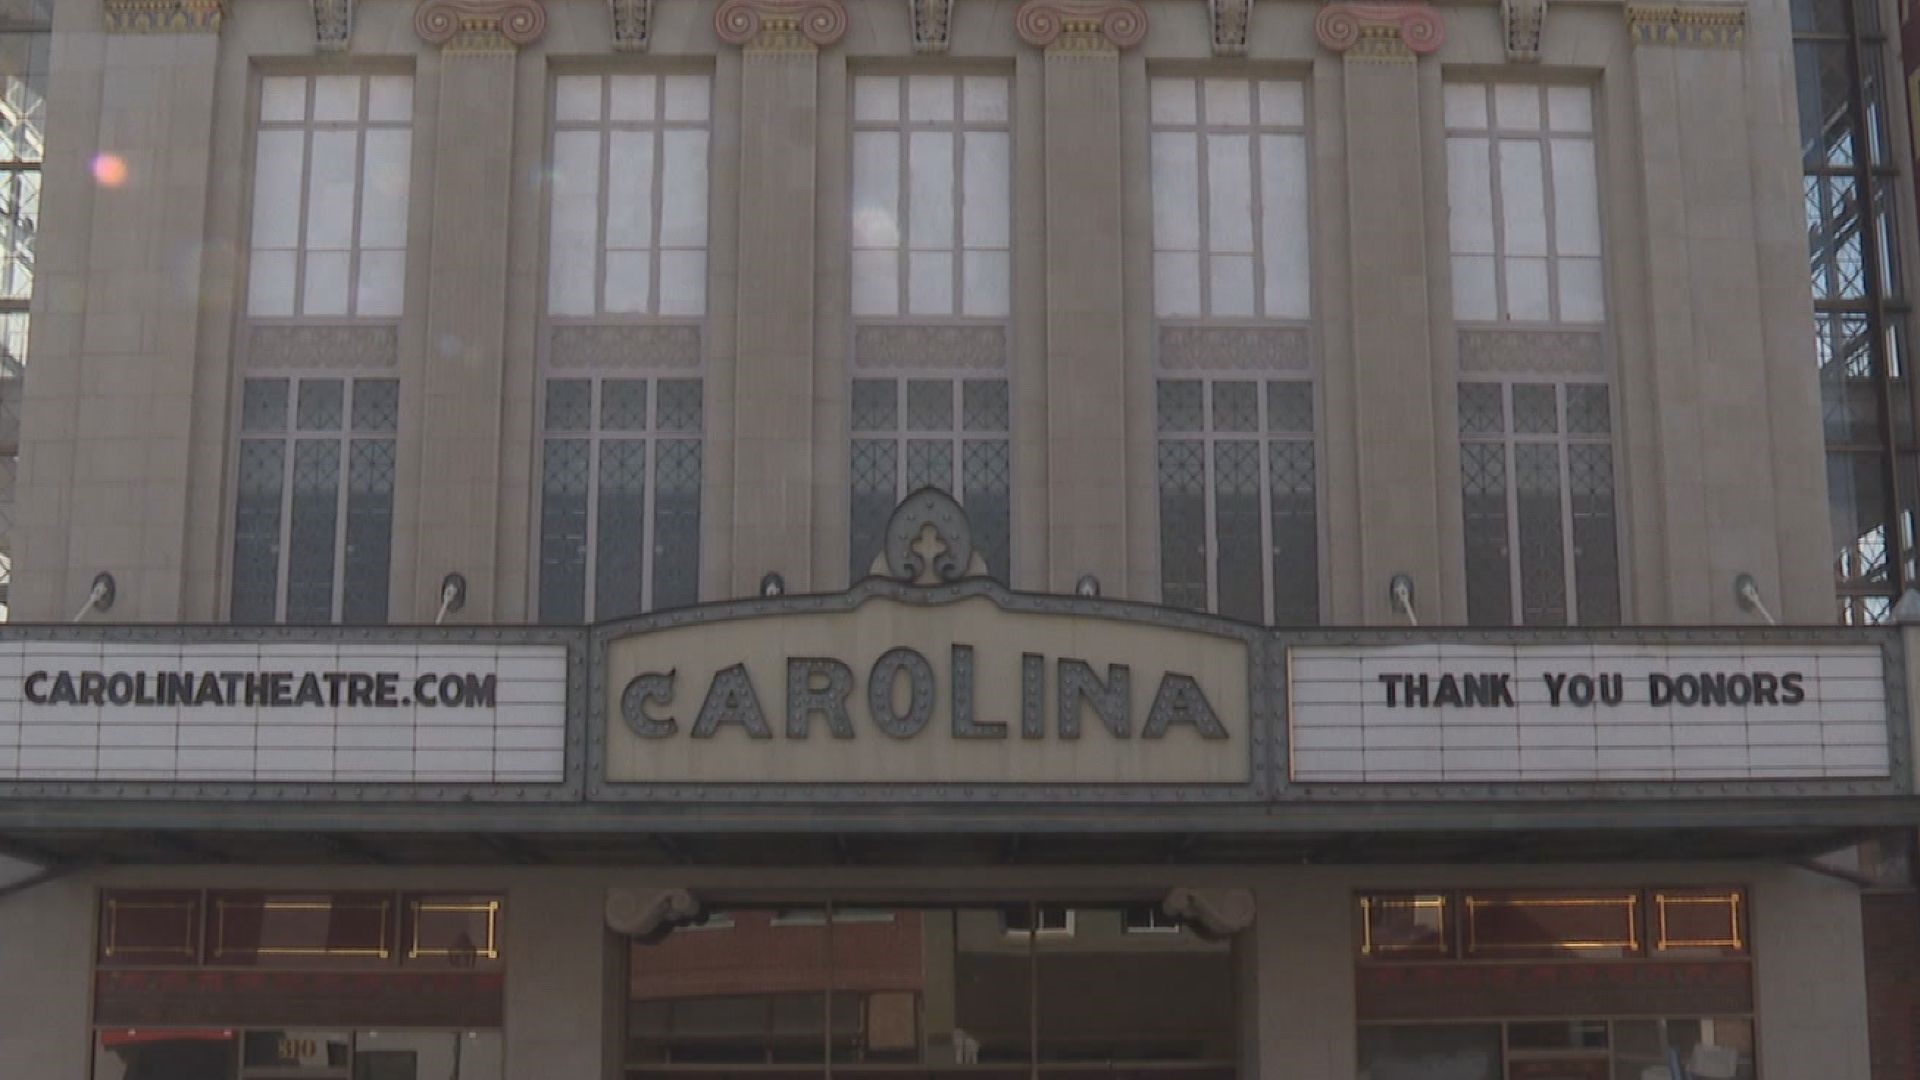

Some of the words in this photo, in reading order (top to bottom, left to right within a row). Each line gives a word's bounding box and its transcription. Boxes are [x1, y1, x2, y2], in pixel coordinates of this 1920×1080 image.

[24, 671, 497, 708] CAROLINATHEATRE.COM
[621, 643, 1230, 739] CAROLINA
[1378, 672, 1514, 707] THANK
[1543, 672, 1624, 706] YOU
[1648, 672, 1805, 706] DONORS
